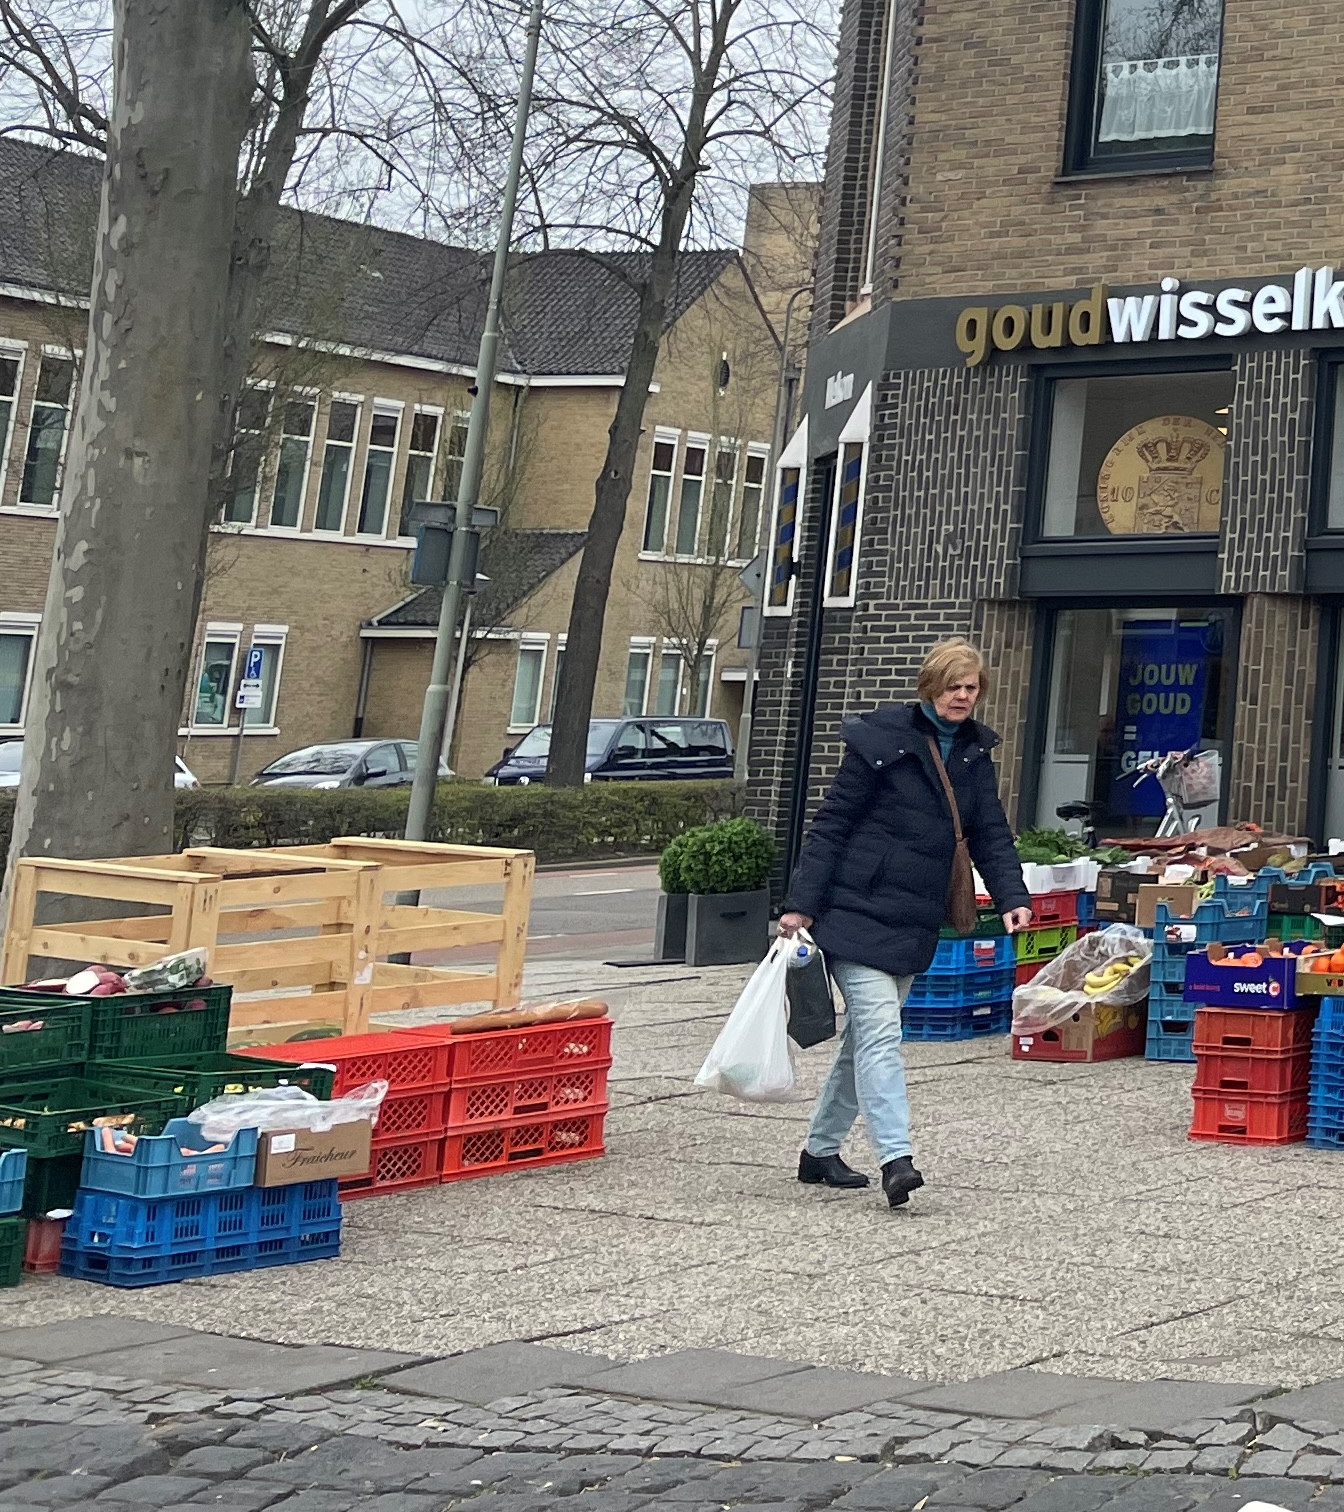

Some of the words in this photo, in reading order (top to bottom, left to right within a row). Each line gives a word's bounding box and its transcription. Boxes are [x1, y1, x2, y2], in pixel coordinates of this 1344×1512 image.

[250, 651, 261, 667] P
[1129, 664, 1198, 686] JOUW
[1127, 693, 1191, 715] GOUD
[1233, 981, 1267, 994] sweet
